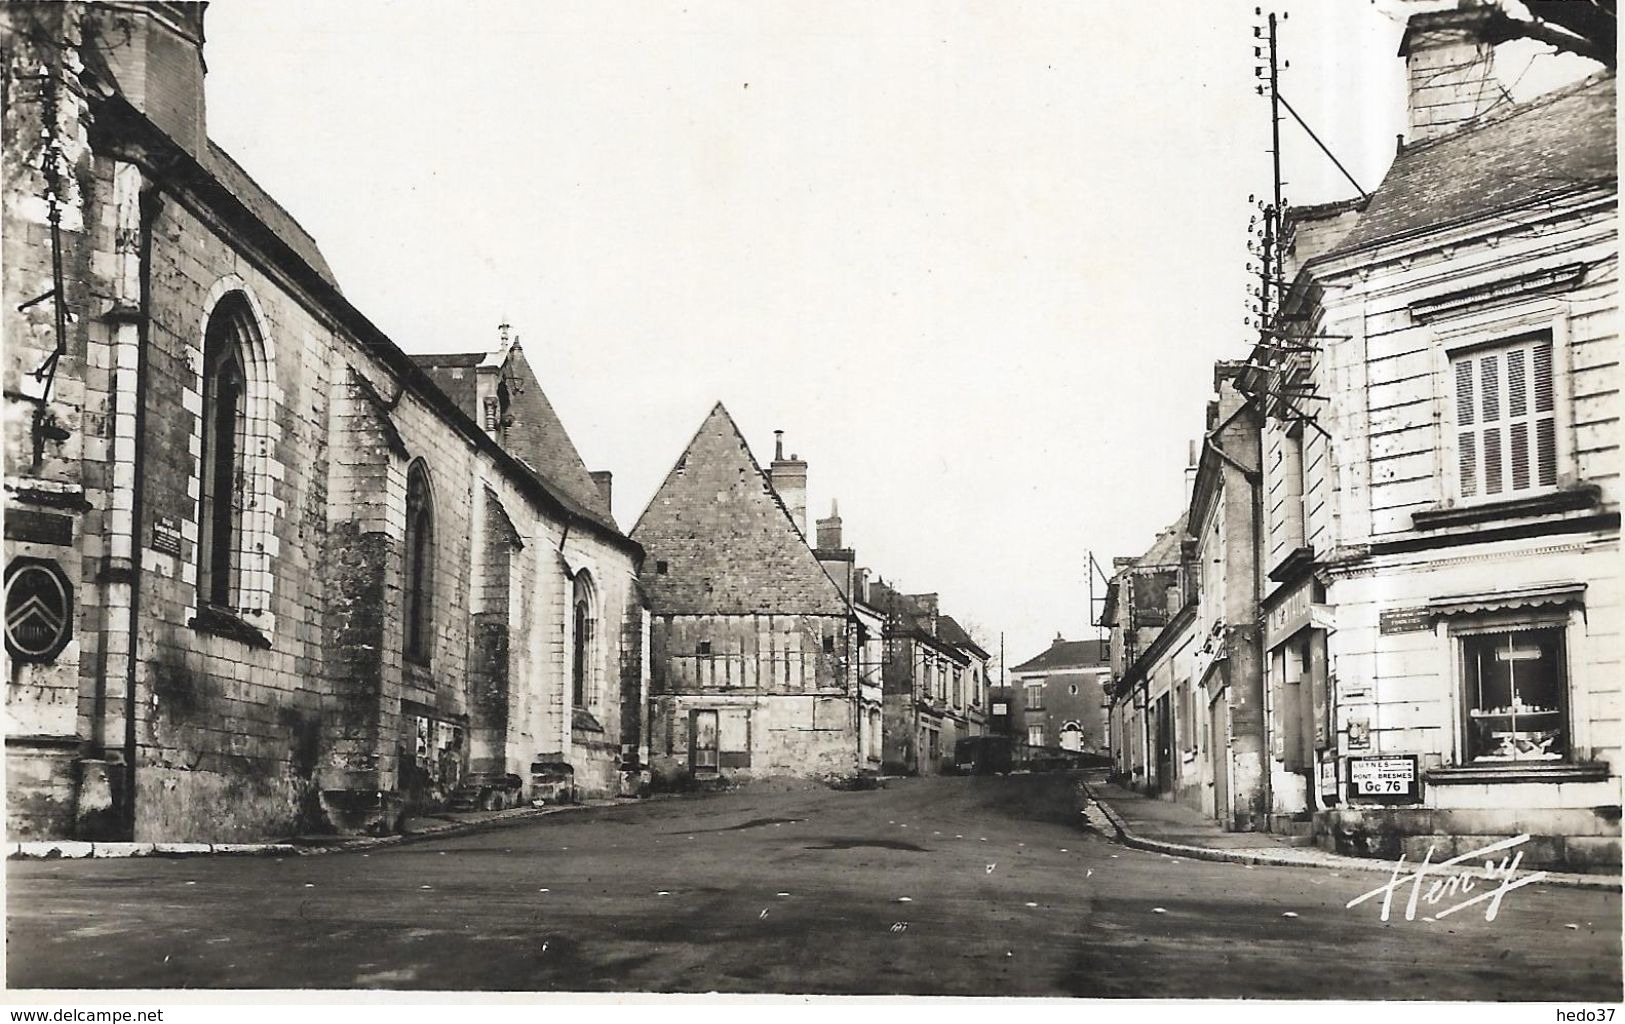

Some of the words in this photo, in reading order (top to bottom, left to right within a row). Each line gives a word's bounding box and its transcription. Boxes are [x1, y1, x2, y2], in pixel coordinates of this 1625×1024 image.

[1353, 761, 1389, 769] LUYNES
[1365, 780, 1381, 792] Gc
[1385, 780, 1401, 792] 76
